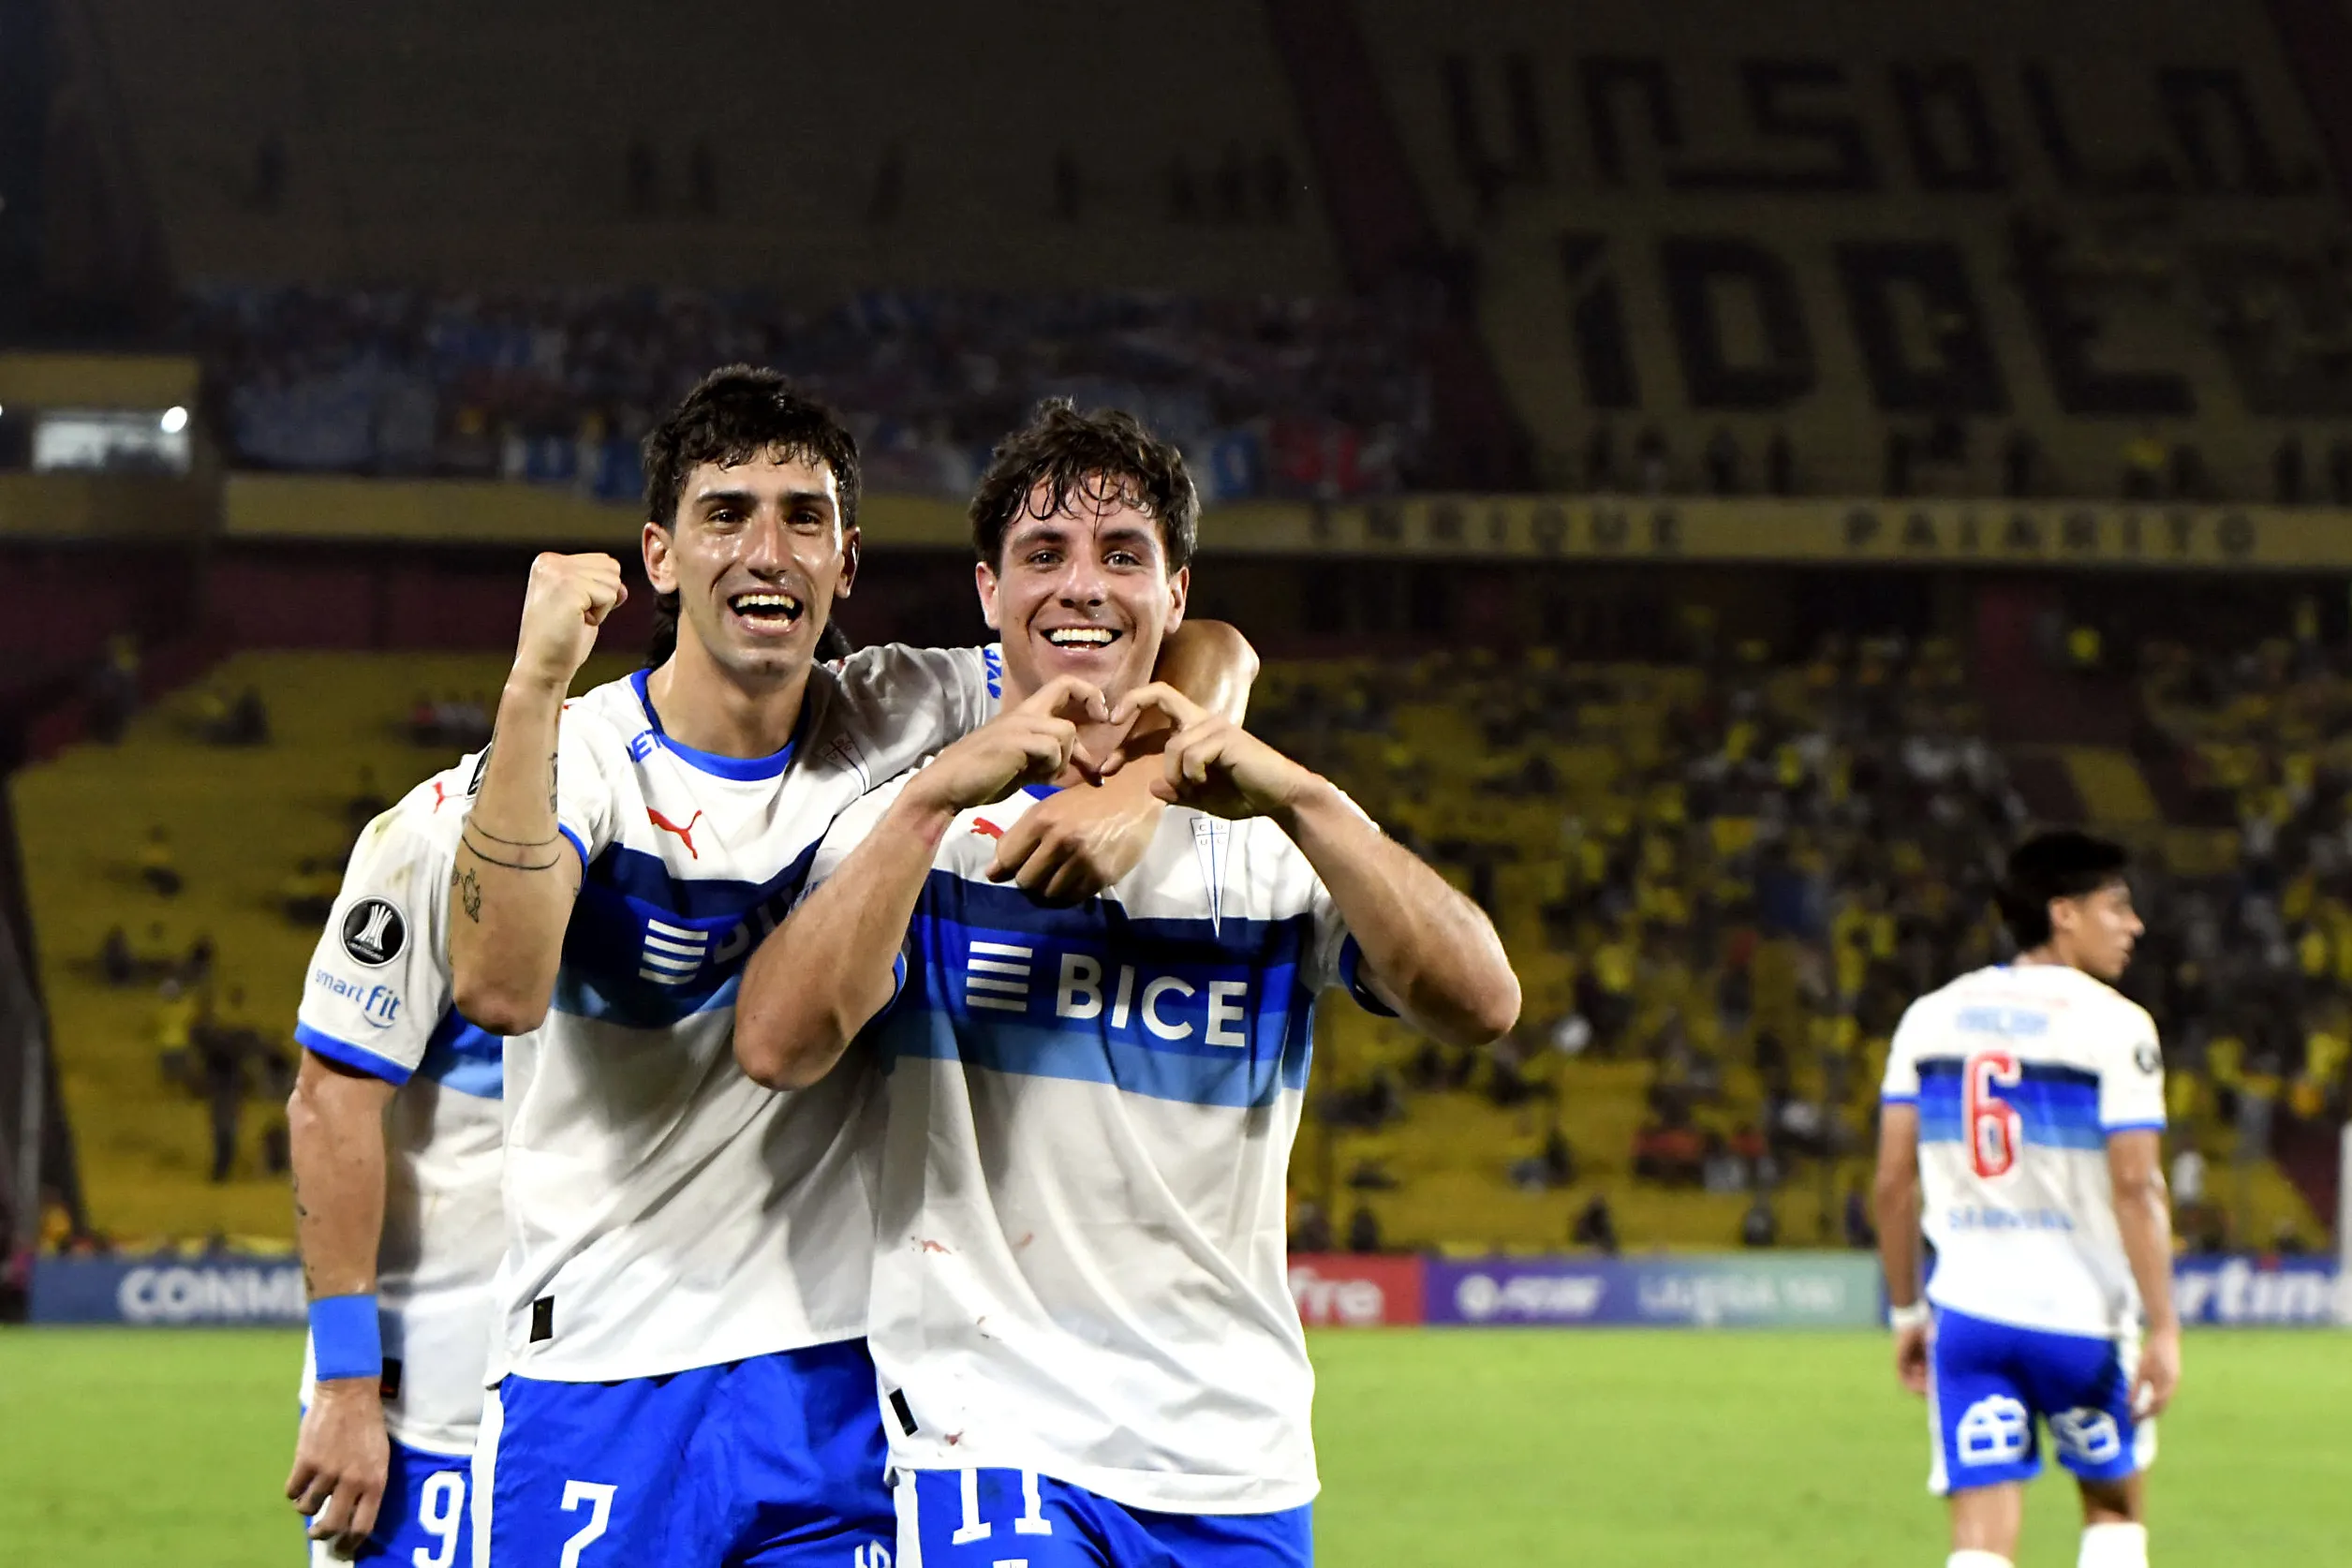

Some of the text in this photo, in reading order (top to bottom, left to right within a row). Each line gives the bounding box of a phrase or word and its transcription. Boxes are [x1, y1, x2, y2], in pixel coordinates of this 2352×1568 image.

[315, 969, 402, 1021] smart fit
[1056, 953, 1248, 1047] BICE
[1964, 1050, 2022, 1182] 6
[412, 1471, 466, 1568] 9
[560, 1479, 618, 1568] 7
